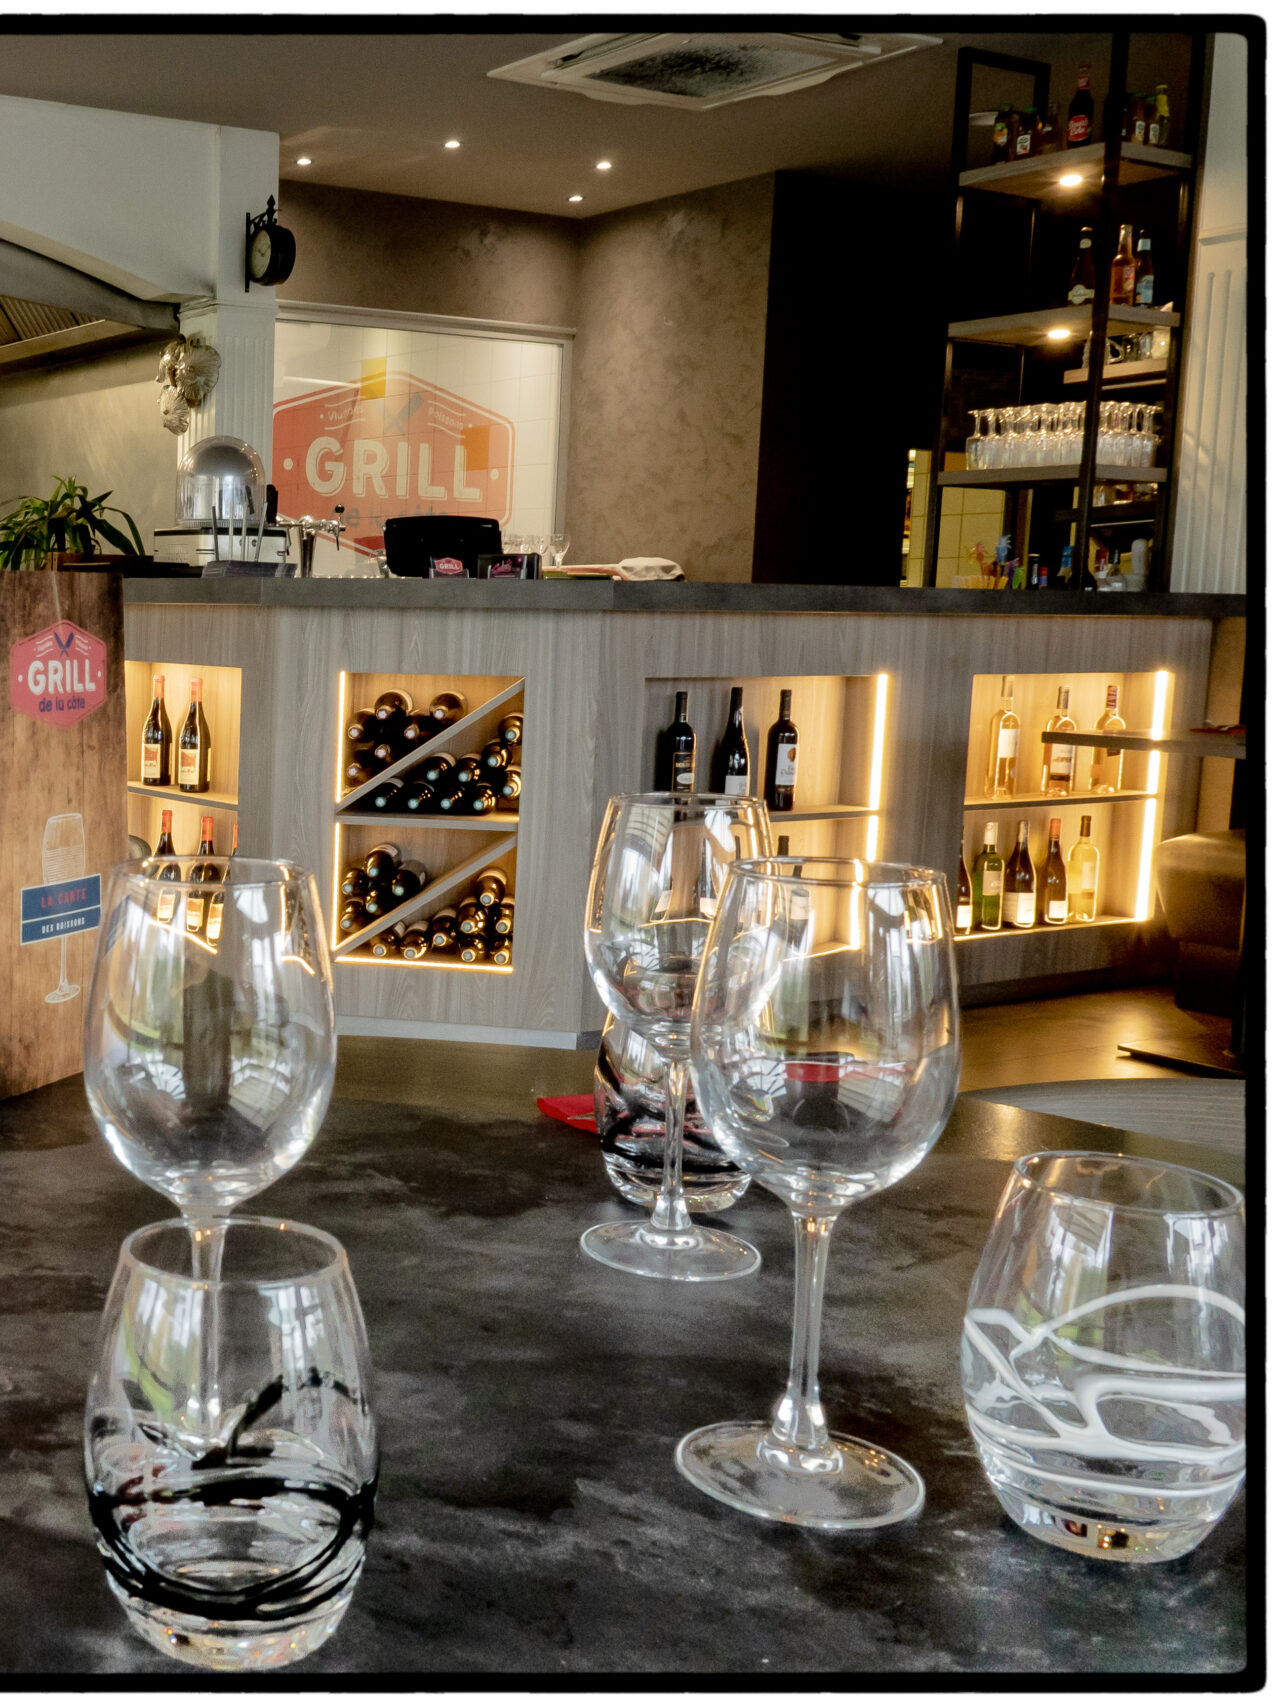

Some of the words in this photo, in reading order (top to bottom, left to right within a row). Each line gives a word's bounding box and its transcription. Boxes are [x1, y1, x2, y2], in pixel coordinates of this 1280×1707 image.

[305, 436, 482, 502] GRILL
[439, 562, 460, 570] GRILL
[28, 659, 96, 695] GRILL
[39, 697, 52, 712] de
[41, 895, 53, 909] LA
[57, 887, 87, 905] CARTE
[41, 924, 54, 934] DES
[56, 916, 85, 931] BOISSONS
